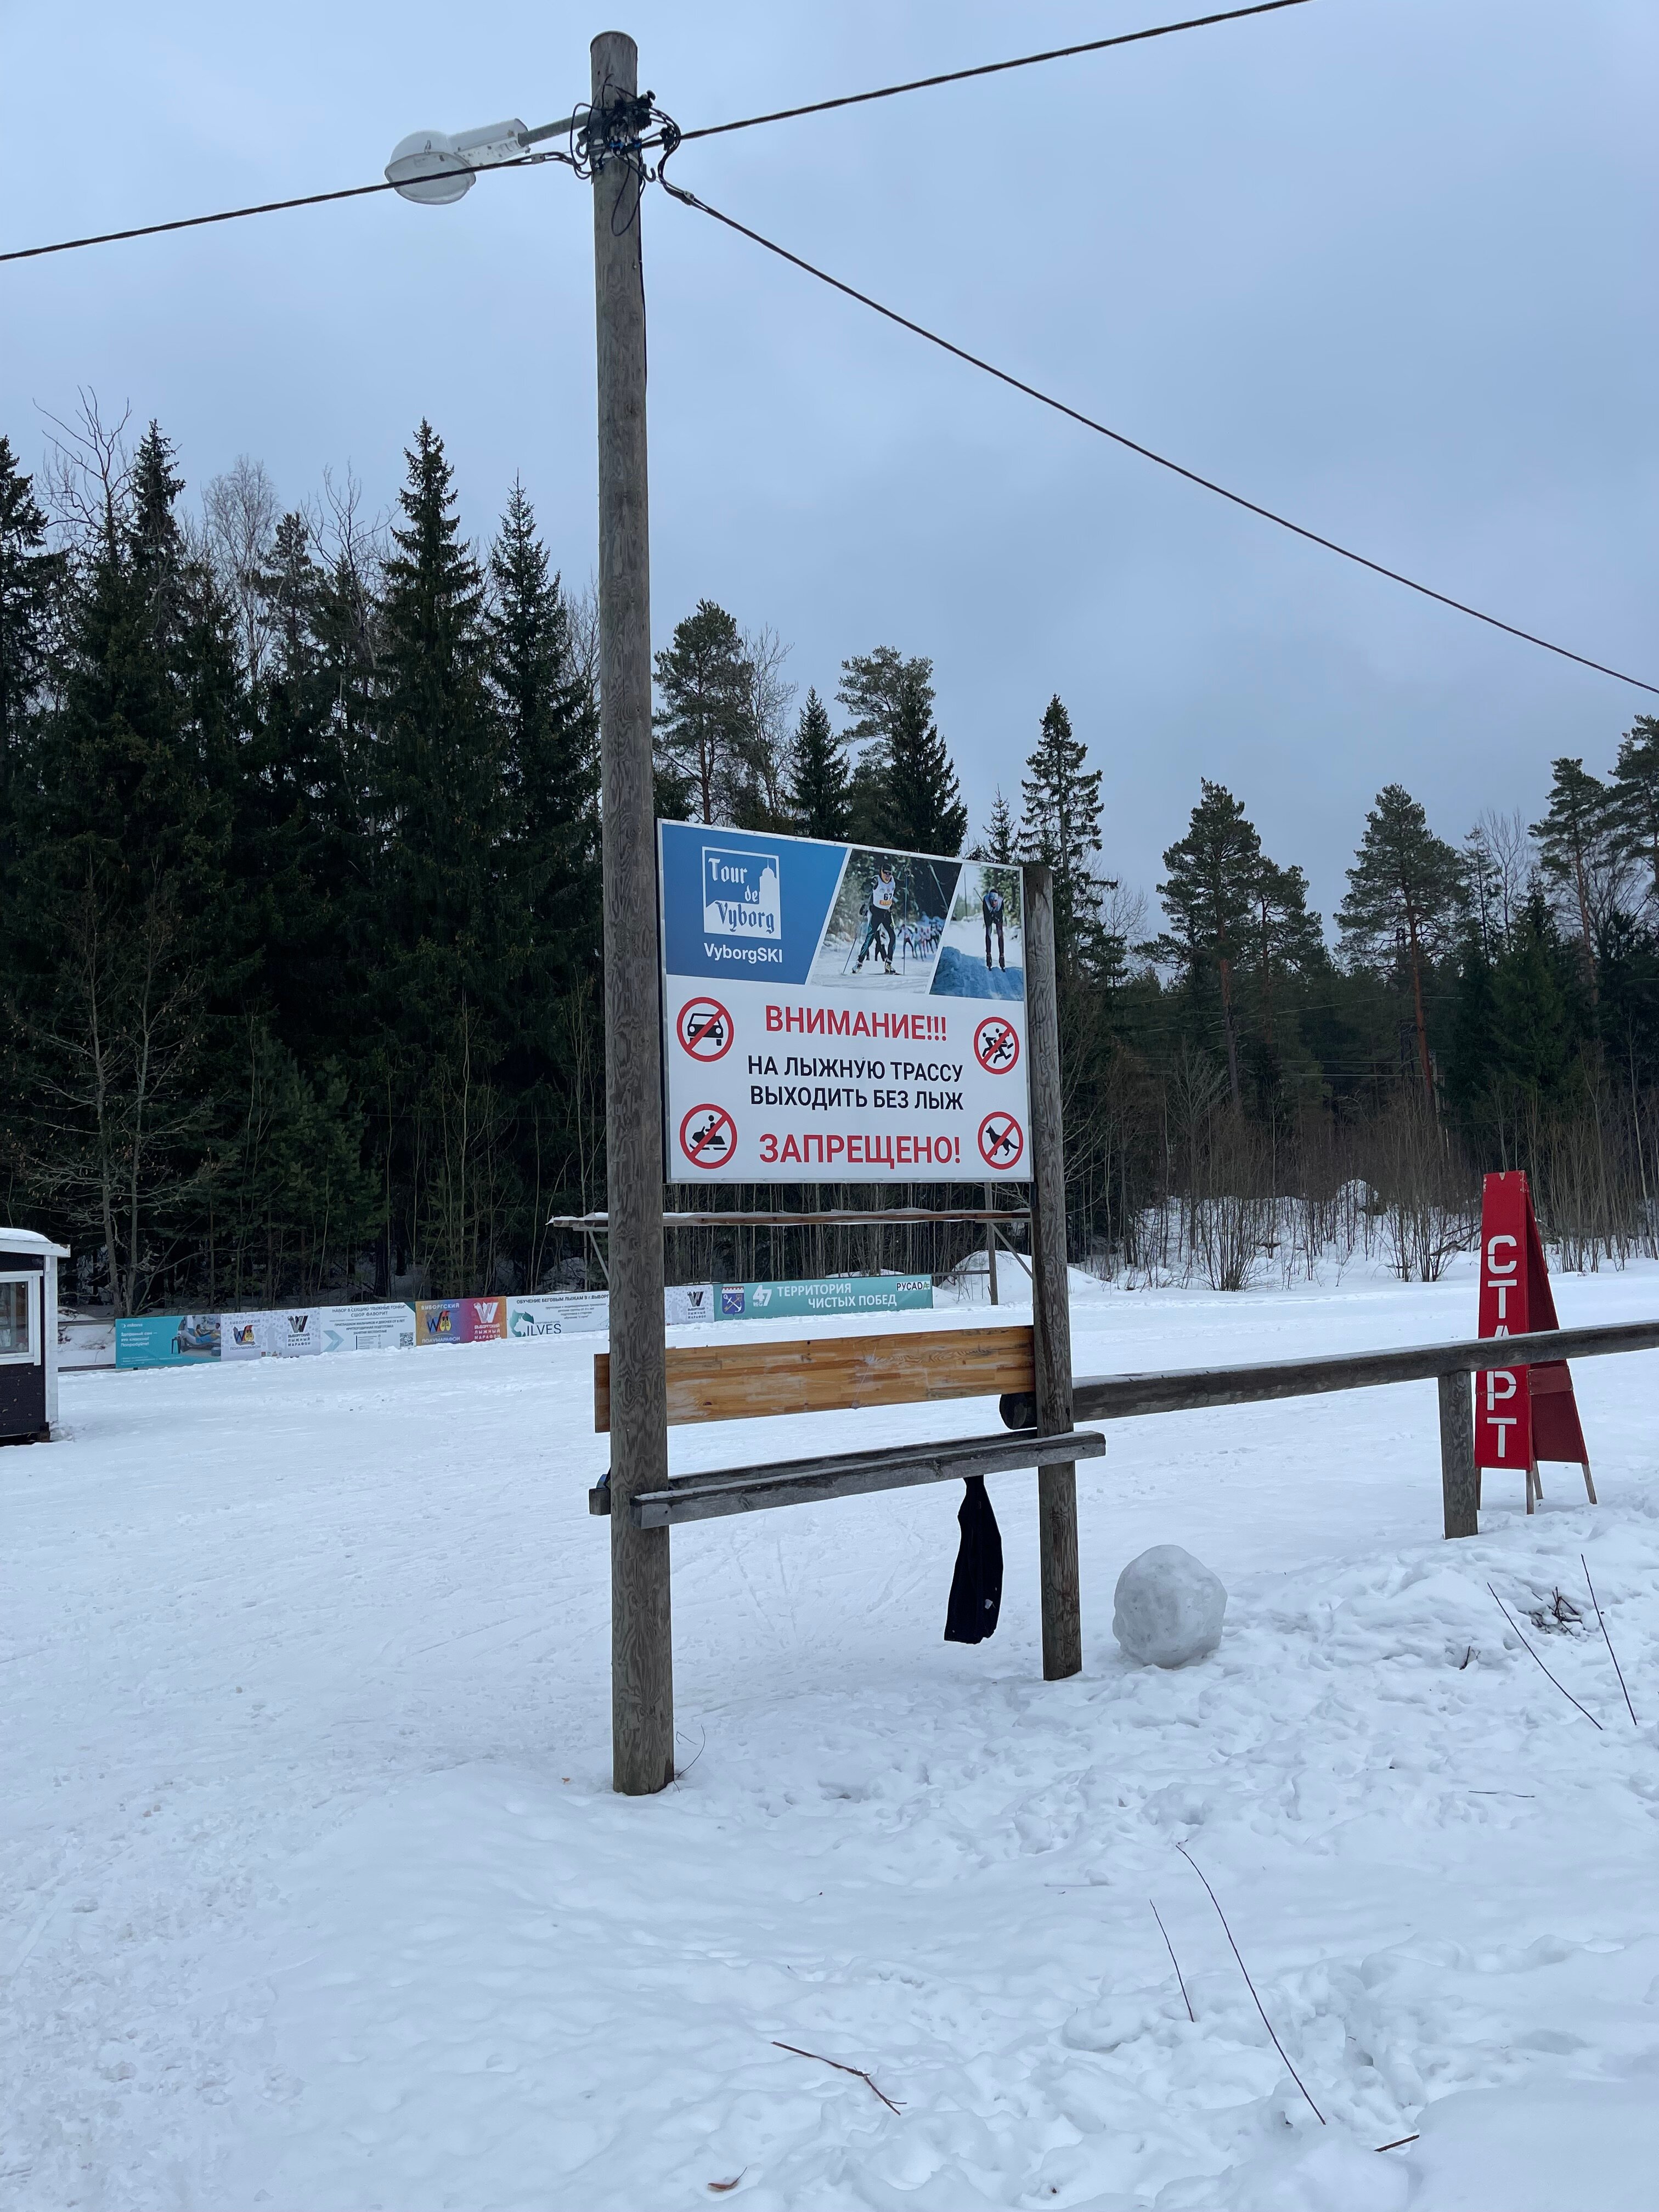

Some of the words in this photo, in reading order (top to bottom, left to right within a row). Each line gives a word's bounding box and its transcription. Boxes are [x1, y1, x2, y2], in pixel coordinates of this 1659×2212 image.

[708, 857, 747, 884] Tour
[744, 885, 758, 902] de
[715, 901, 774, 934] Vyborg
[703, 943, 782, 964] VyborgSKI
[765, 1005, 947, 1041] ВНИМАНИЕ!!!
[748, 1055, 778, 1075] НА
[785, 1057, 885, 1080] ЛЫЖНУЮ
[890, 1061, 963, 1082] ТРАССУ
[750, 1085, 867, 1110] ВЫХОДИТЬ
[873, 1089, 909, 1109] БЕЗ
[914, 1091, 964, 1110] ЛЫЖ
[759, 1133, 961, 1169] ЗАПРЕЩЕНО!
[777, 1283, 851, 1297] ТЕРРИТОРИЯ
[808, 1296, 855, 1308] ЧИСТЫХ
[859, 1294, 897, 1307] ПОБЕД
[527, 1323, 562, 1336] ILVES
